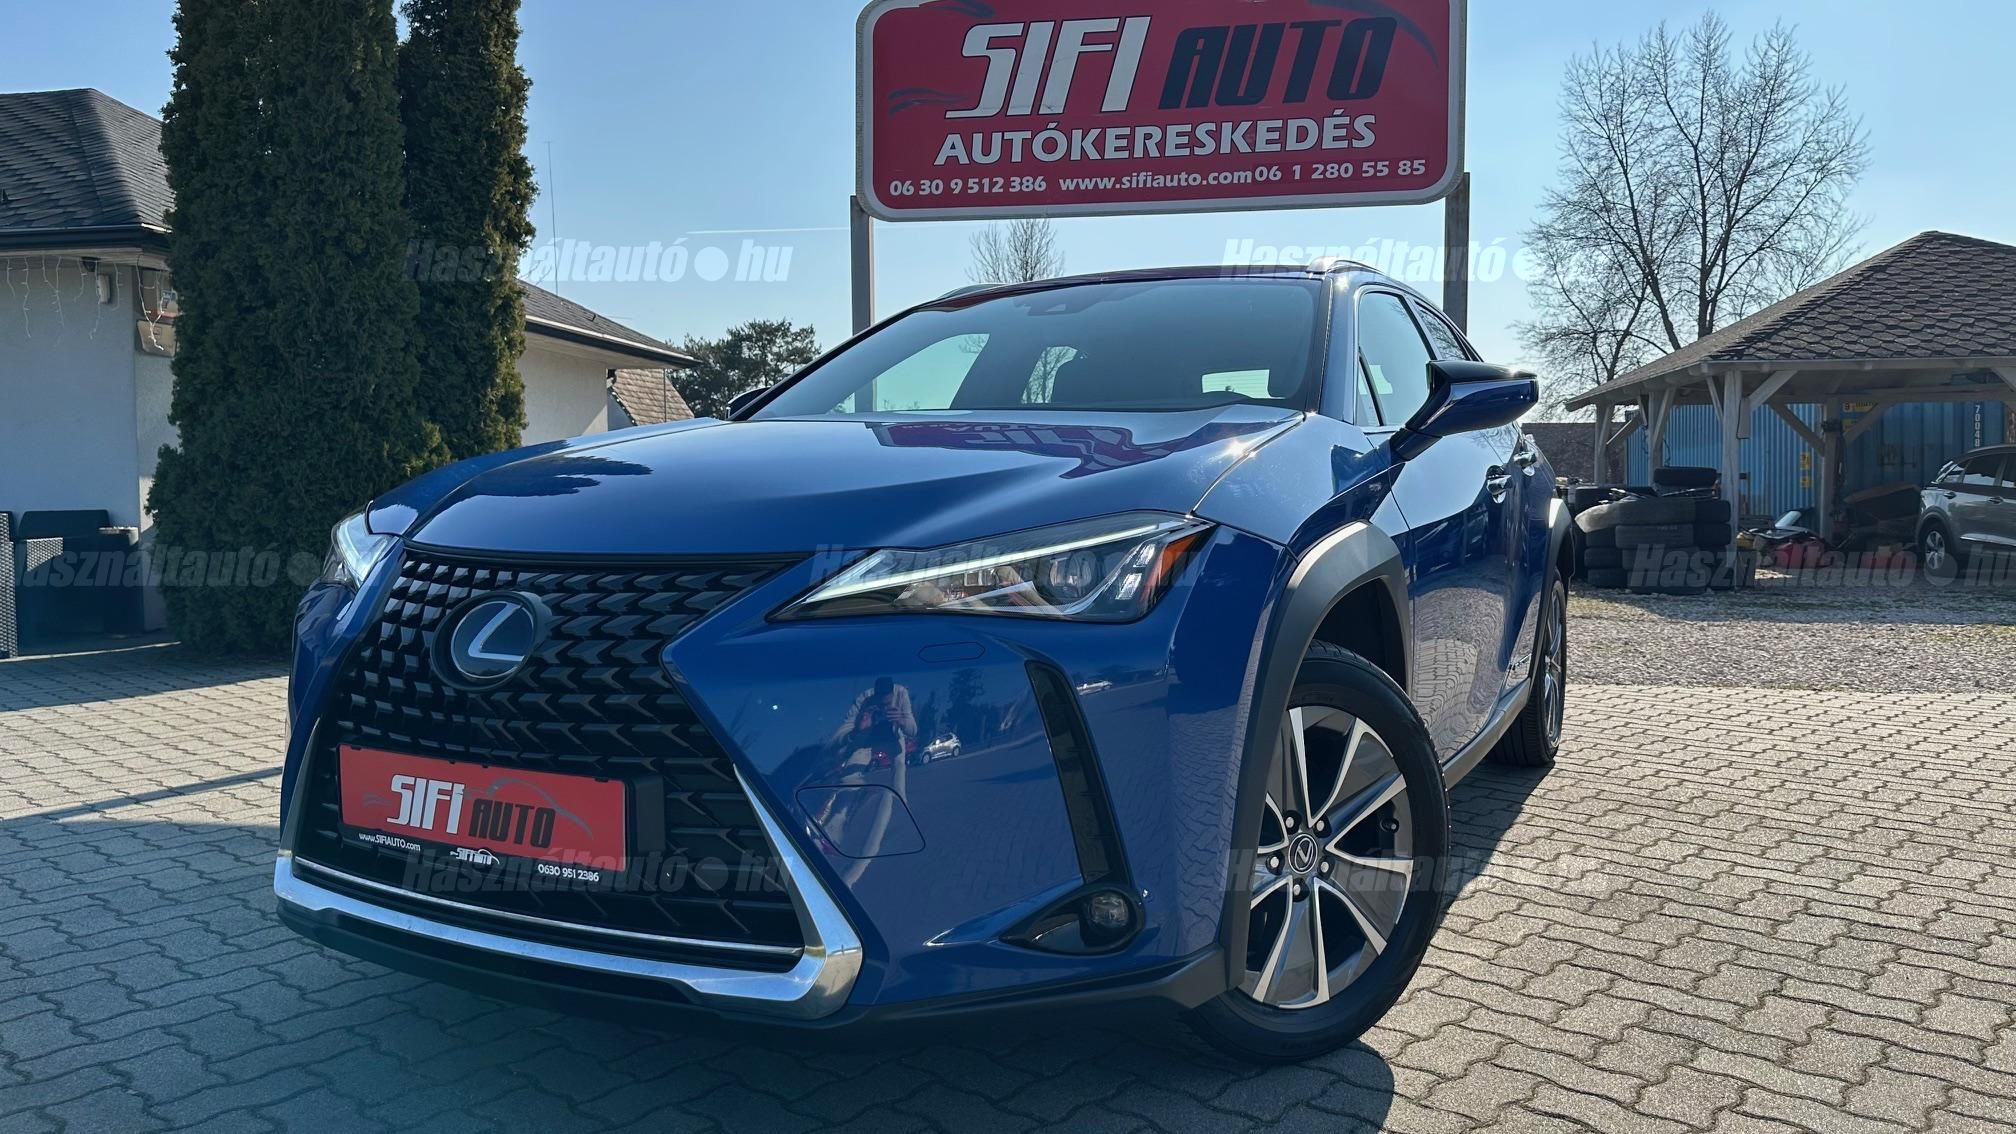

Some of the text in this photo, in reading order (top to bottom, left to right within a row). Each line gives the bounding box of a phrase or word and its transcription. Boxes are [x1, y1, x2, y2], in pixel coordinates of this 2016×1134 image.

[944, 15, 1398, 120] SIFI AUTO
[933, 108, 1377, 167] AUTÓKERESKEDÉS
[889, 180, 915, 196] 06
[918, 179, 944, 195] 30
[1009, 175, 1047, 192] 386
[1059, 168, 1252, 191] www.sifiauto.com
[1254, 165, 1282, 182] 06
[1292, 164, 1301, 180] 1
[1311, 162, 1354, 179] 280
[1361, 161, 1389, 177] 55
[1398, 159, 1426, 175] 85
[386, 774, 556, 849] SIFI AUTO
[358, 833, 421, 852] www.SIFIAUTO.com
[537, 863, 561, 876] 0630
